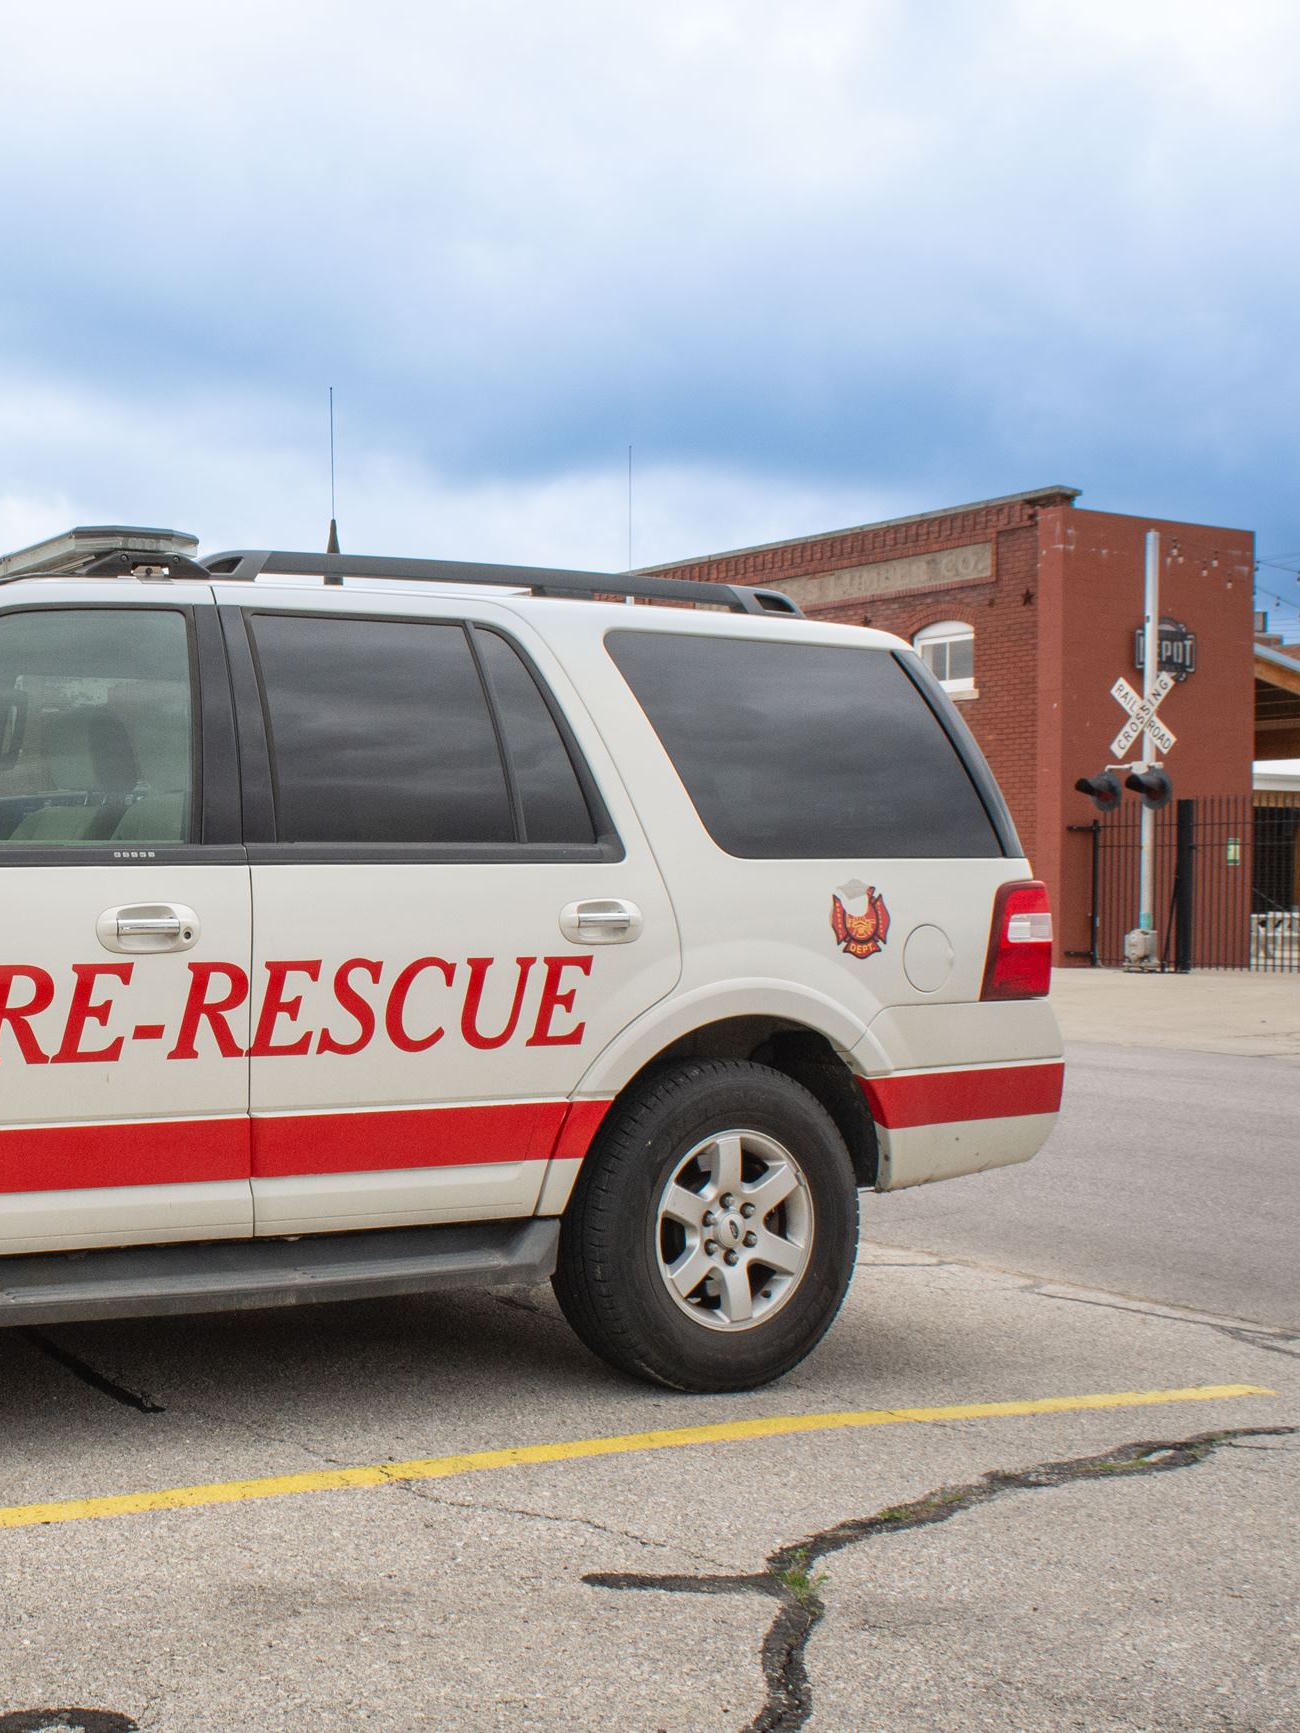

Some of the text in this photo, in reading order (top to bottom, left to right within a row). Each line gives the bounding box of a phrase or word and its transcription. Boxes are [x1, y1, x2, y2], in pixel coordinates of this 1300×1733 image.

[1139, 635, 1193, 666] POT
[1115, 684, 1172, 749] RAIL ROAD
[1117, 679, 1169, 750] CROSSING
